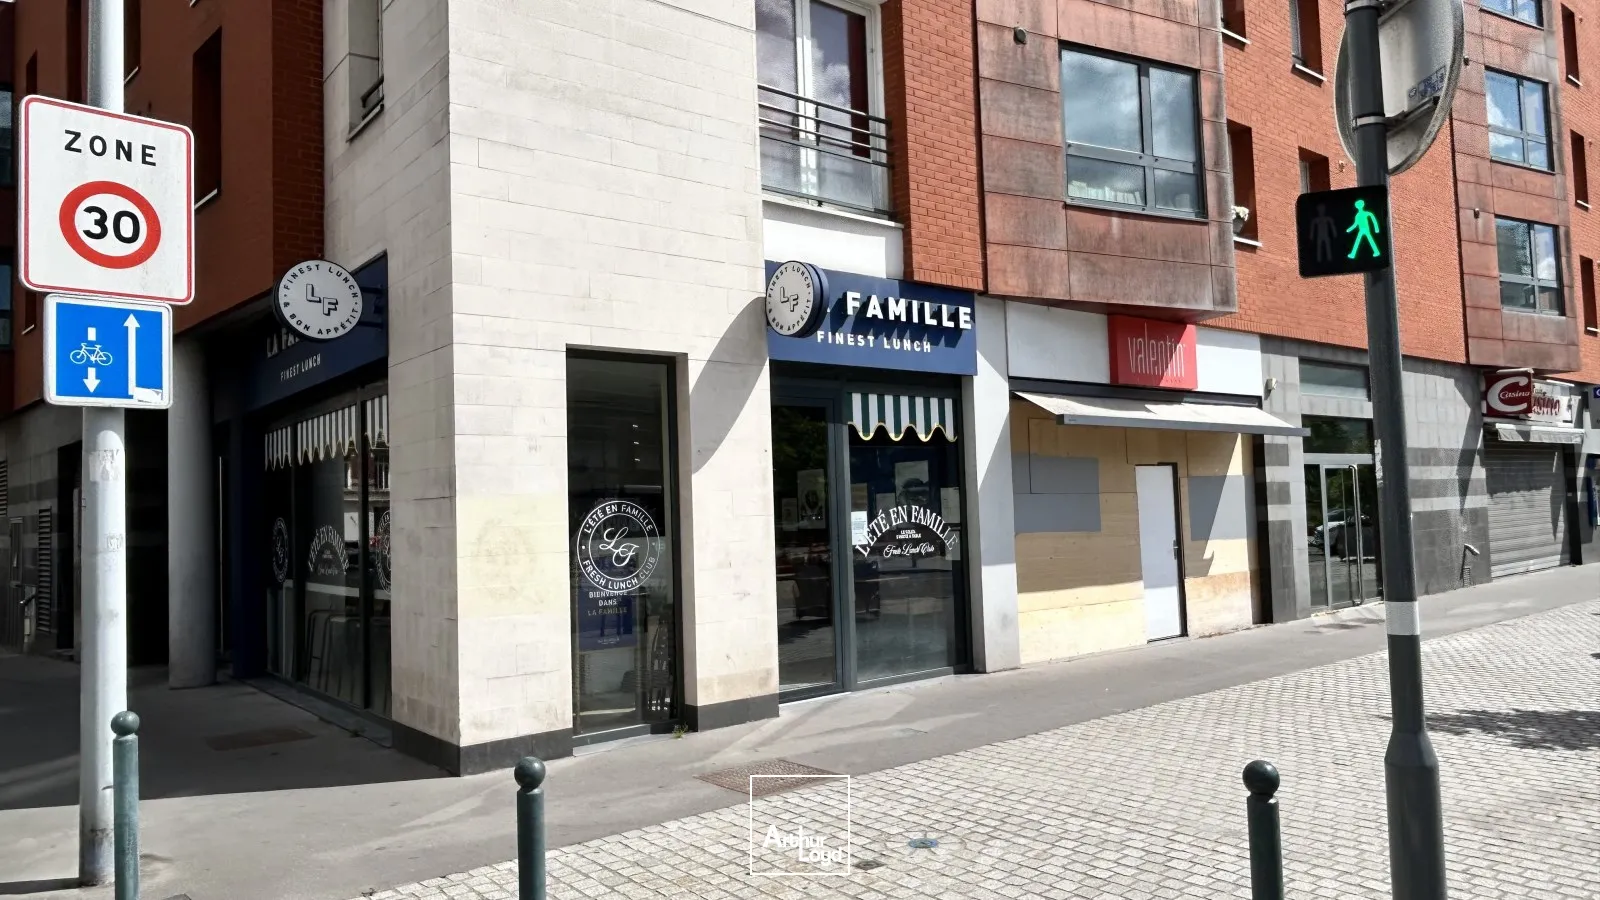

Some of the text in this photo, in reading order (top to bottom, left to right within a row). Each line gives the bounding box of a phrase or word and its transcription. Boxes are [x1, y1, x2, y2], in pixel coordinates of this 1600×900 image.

[64, 128, 157, 167] ZONE
[82, 205, 141, 244] 30
[283, 264, 359, 299] FINEST LUNCH
[767, 265, 812, 298] FINEST LUNCH
[289, 313, 311, 332] BON
[317, 308, 359, 335] APPÉTIT
[771, 316, 784, 330] BON
[846, 290, 972, 330] FAMILLE
[816, 330, 931, 353] FINEST LUNCH
[1127, 321, 1185, 378] valentin
[280, 352, 321, 382] FINEST LUNCH
[1499, 390, 1530, 400] Casino
[584, 504, 654, 534] L'ÉTÉ EN FAMILLE
[889, 505, 908, 526] EN
[911, 505, 959, 551] FAMILLE
[582, 556, 656, 590] FRESH LUNCH CLUB
[598, 599, 617, 607] DANS
[598, 607, 628, 616] FAMILLE
